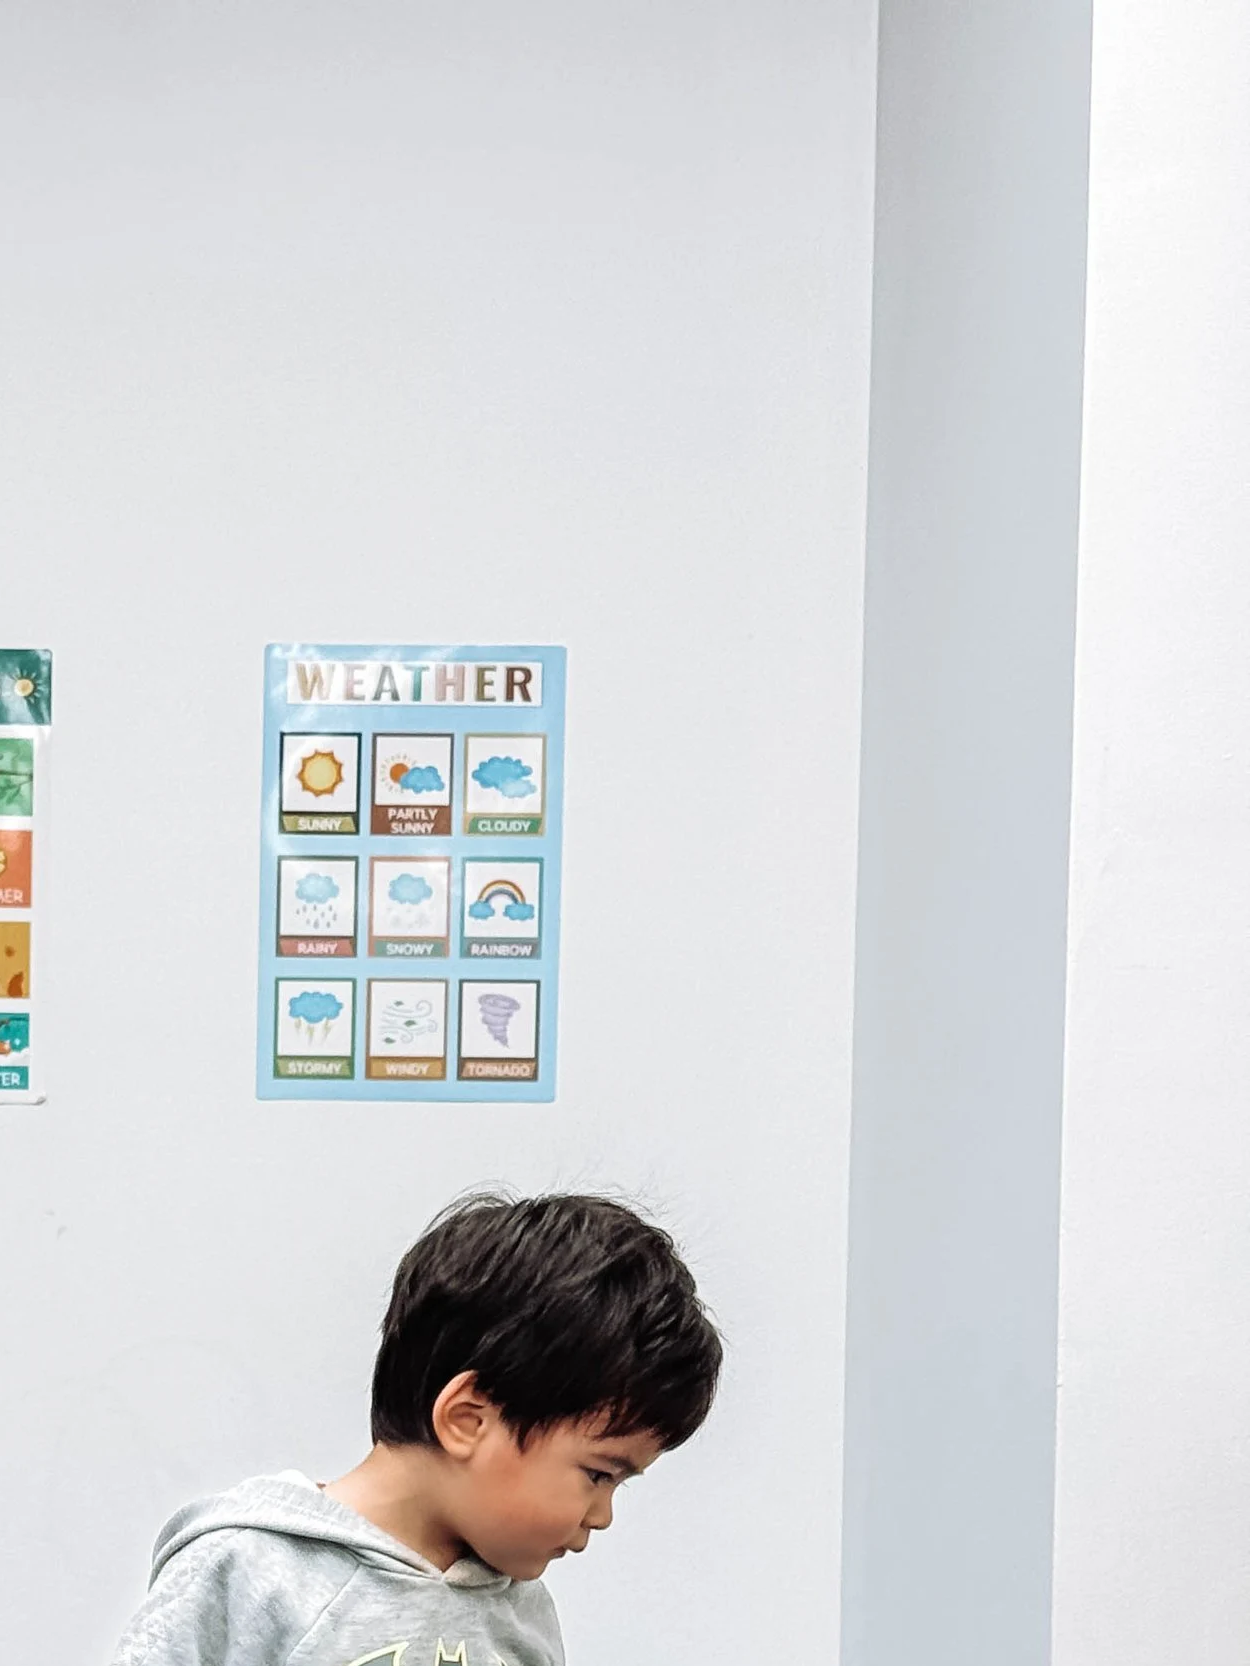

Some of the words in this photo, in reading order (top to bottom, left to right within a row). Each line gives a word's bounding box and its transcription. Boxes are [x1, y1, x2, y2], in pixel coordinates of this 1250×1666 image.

[295, 662, 534, 703] WEATHER
[387, 807, 439, 821] PARTLY
[297, 818, 343, 832] SUNNY
[390, 820, 435, 834] SUNNY
[478, 819, 531, 833] CLOUDY
[297, 941, 339, 955] RAINY
[386, 942, 434, 956] SNOWY
[470, 943, 533, 957] RAINBOW
[287, 1061, 342, 1076] STORMY
[385, 1062, 430, 1076] WINDY
[467, 1063, 531, 1077] TORNADO
